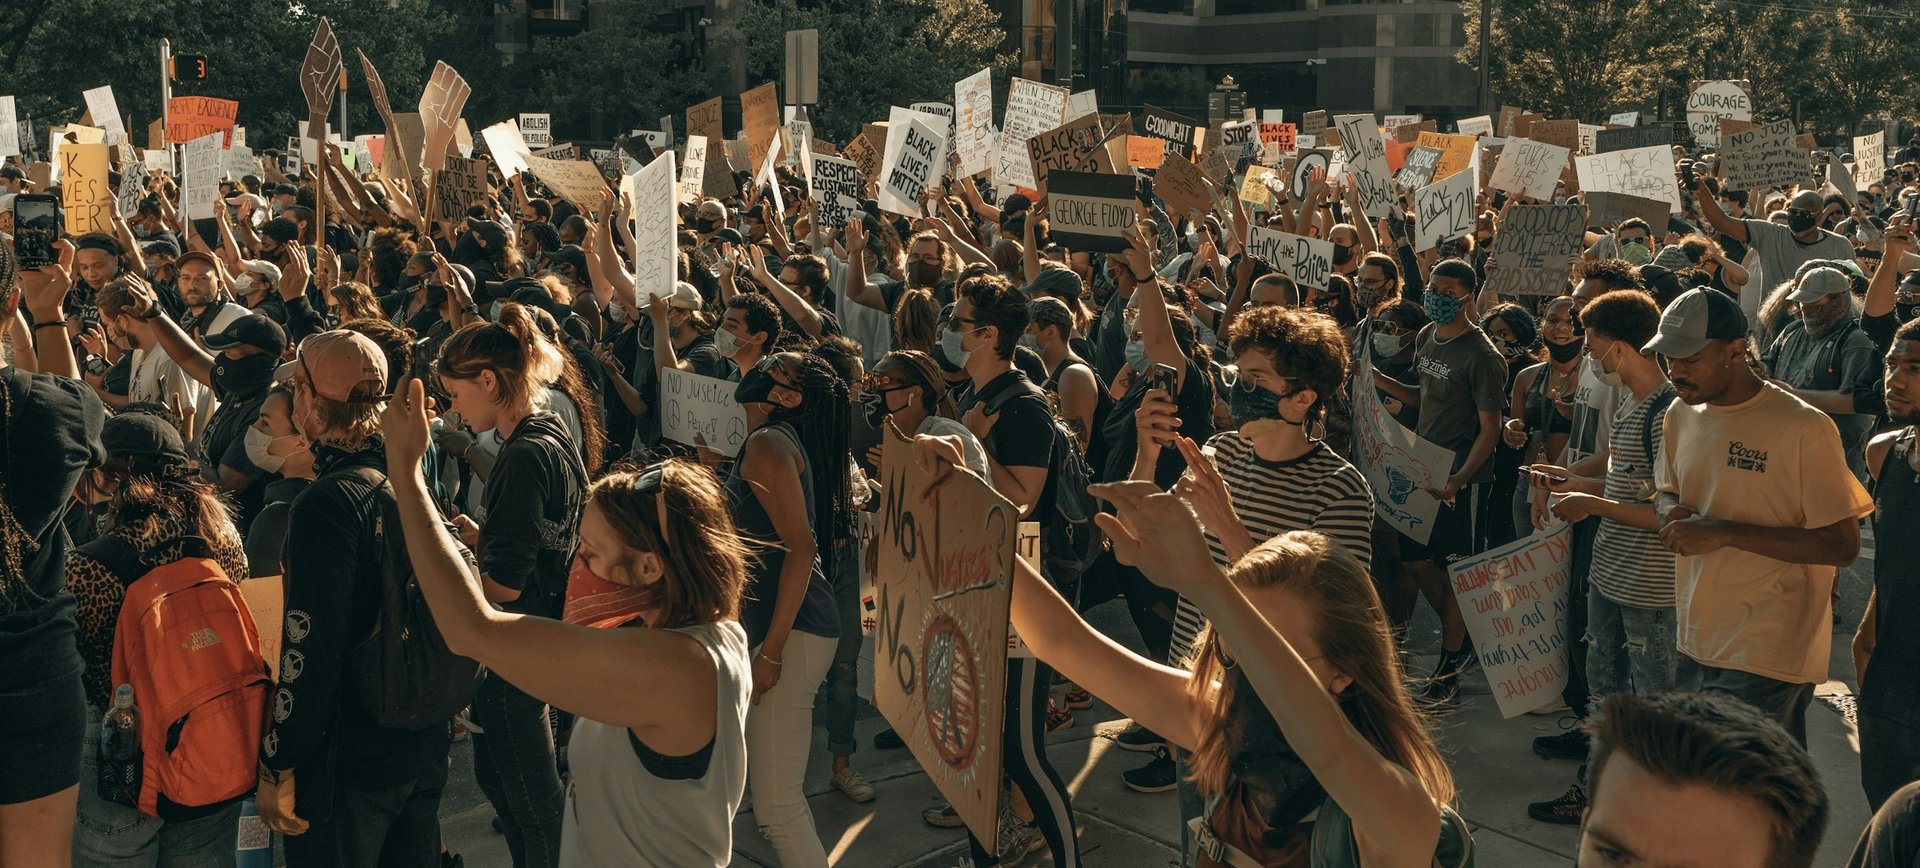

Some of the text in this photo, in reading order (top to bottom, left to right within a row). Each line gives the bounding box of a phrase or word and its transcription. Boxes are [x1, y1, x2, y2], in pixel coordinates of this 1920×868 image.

[196, 59, 206, 78] 3
[1015, 81, 1064, 106] WHEN IT'S
[1689, 92, 1746, 111] COURAGE
[522, 117, 548, 129] ABOLISH
[1145, 115, 1192, 143] GOODNIGHT
[1260, 124, 1291, 133] BLACK
[1386, 119, 1398, 128] IF
[531, 133, 547, 143] POLICE
[905, 127, 936, 162] BLACK
[1031, 128, 1080, 161] BLACK
[1224, 125, 1253, 146] STOP
[1259, 135, 1291, 144] LIVES
[1421, 135, 1453, 148] BLACK
[1731, 131, 1755, 148] NO
[1863, 135, 1877, 147] NO
[1165, 140, 1185, 155] IGHT
[1279, 143, 1295, 151] TER
[61, 151, 82, 178] K
[900, 151, 929, 183] LIVES
[1515, 143, 1550, 175] FUCK
[1589, 150, 1664, 176] BLACK
[1864, 158, 1877, 171] NO
[815, 158, 857, 184] RESPECT
[1513, 166, 1538, 187] 45
[1855, 166, 1882, 183] PEACE
[454, 175, 465, 189] TO
[888, 167, 924, 203] MATTER
[823, 190, 839, 206] OR
[1054, 199, 1135, 229] GEORGE FLOYD
[1506, 205, 1587, 233] GOOD COPS
[1279, 244, 1295, 259] the
[1292, 237, 1329, 287] Police
[1518, 250, 1545, 268] THE
[1487, 268, 1521, 292] BAD
[687, 410, 718, 443] Peace!
[1728, 440, 1768, 461] Coors
